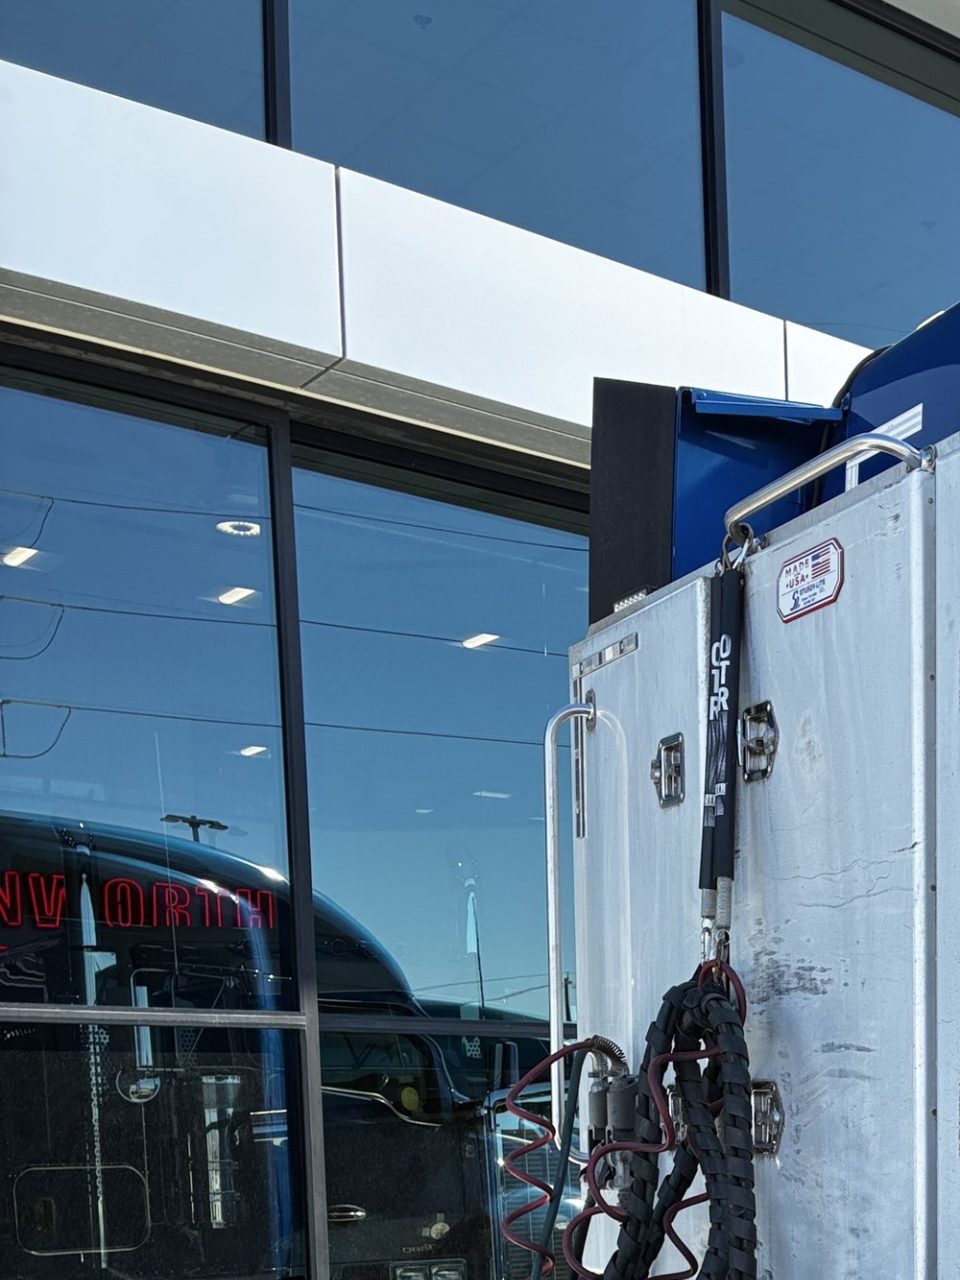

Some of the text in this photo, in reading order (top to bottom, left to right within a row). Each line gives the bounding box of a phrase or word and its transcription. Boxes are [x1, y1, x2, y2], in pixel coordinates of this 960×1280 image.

[785, 558, 809, 577] MADE
[789, 575, 806, 588] USA
[718, 633, 732, 711] OTR
